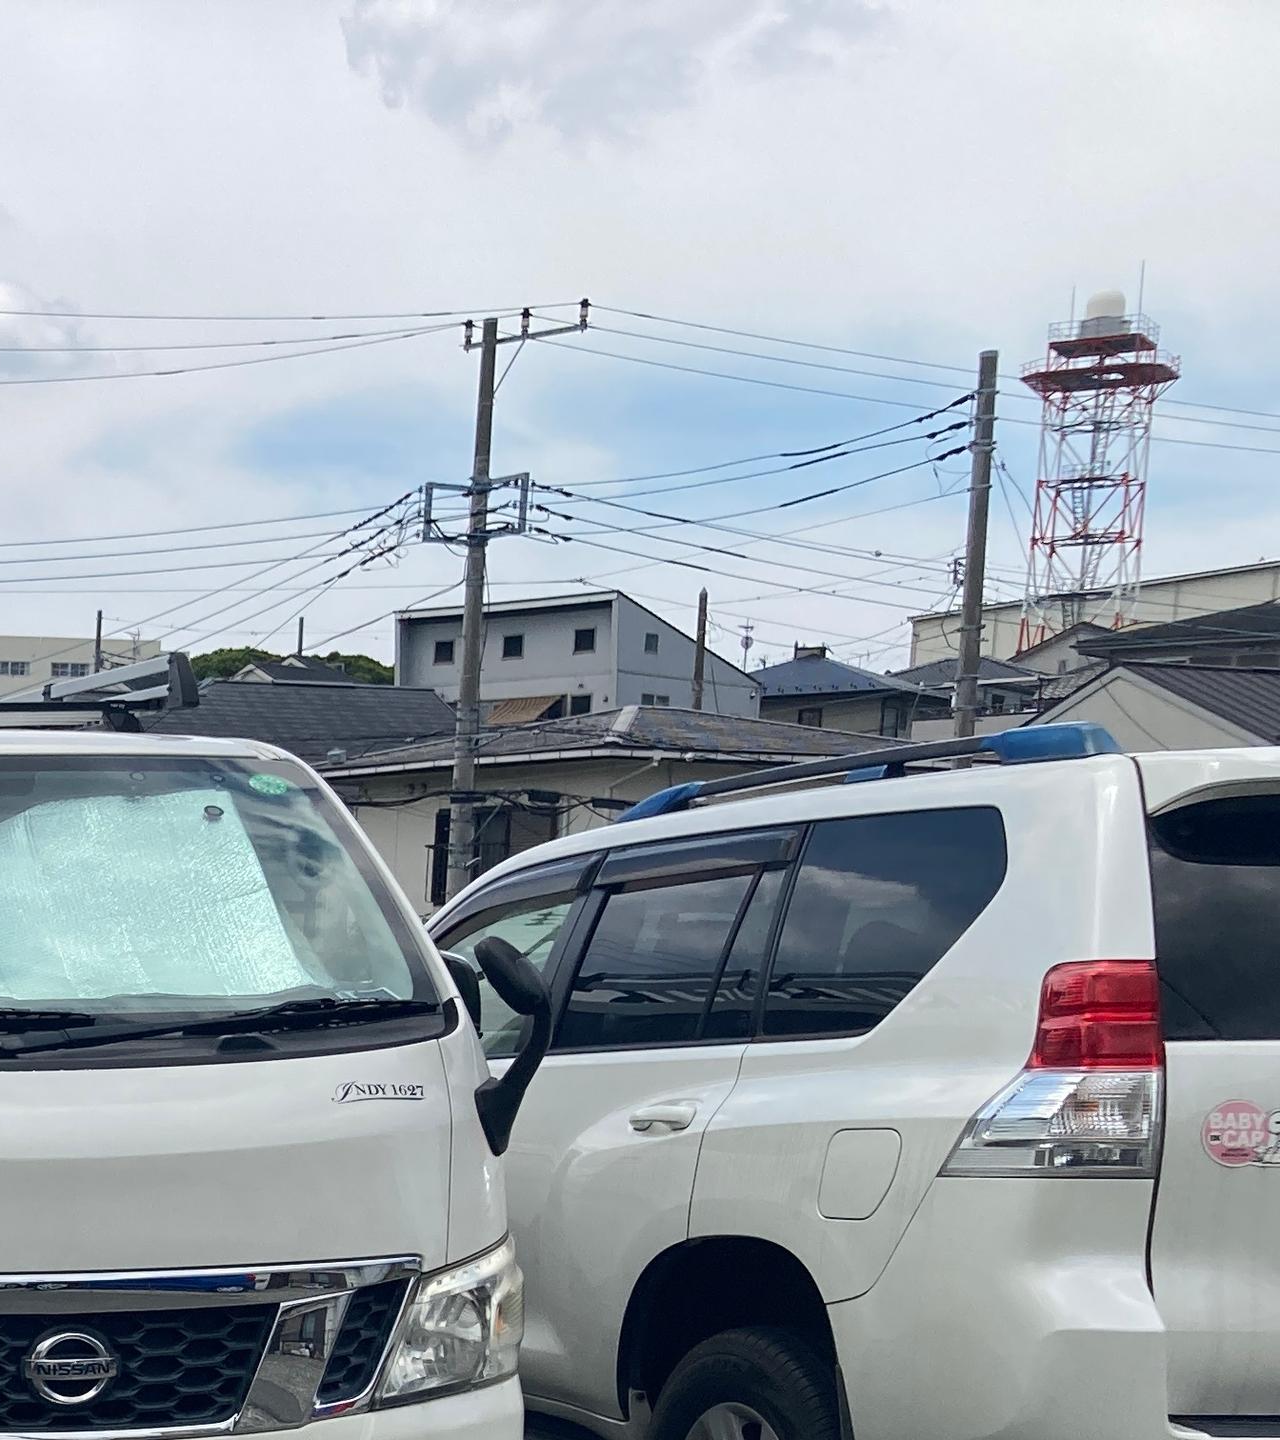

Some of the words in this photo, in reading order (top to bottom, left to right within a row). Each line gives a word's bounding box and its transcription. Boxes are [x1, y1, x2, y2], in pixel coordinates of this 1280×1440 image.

[391, 1084, 425, 1096] 1627
[1209, 1112, 1266, 1129] BABY
[36, 1362, 111, 1376] NISSAN
